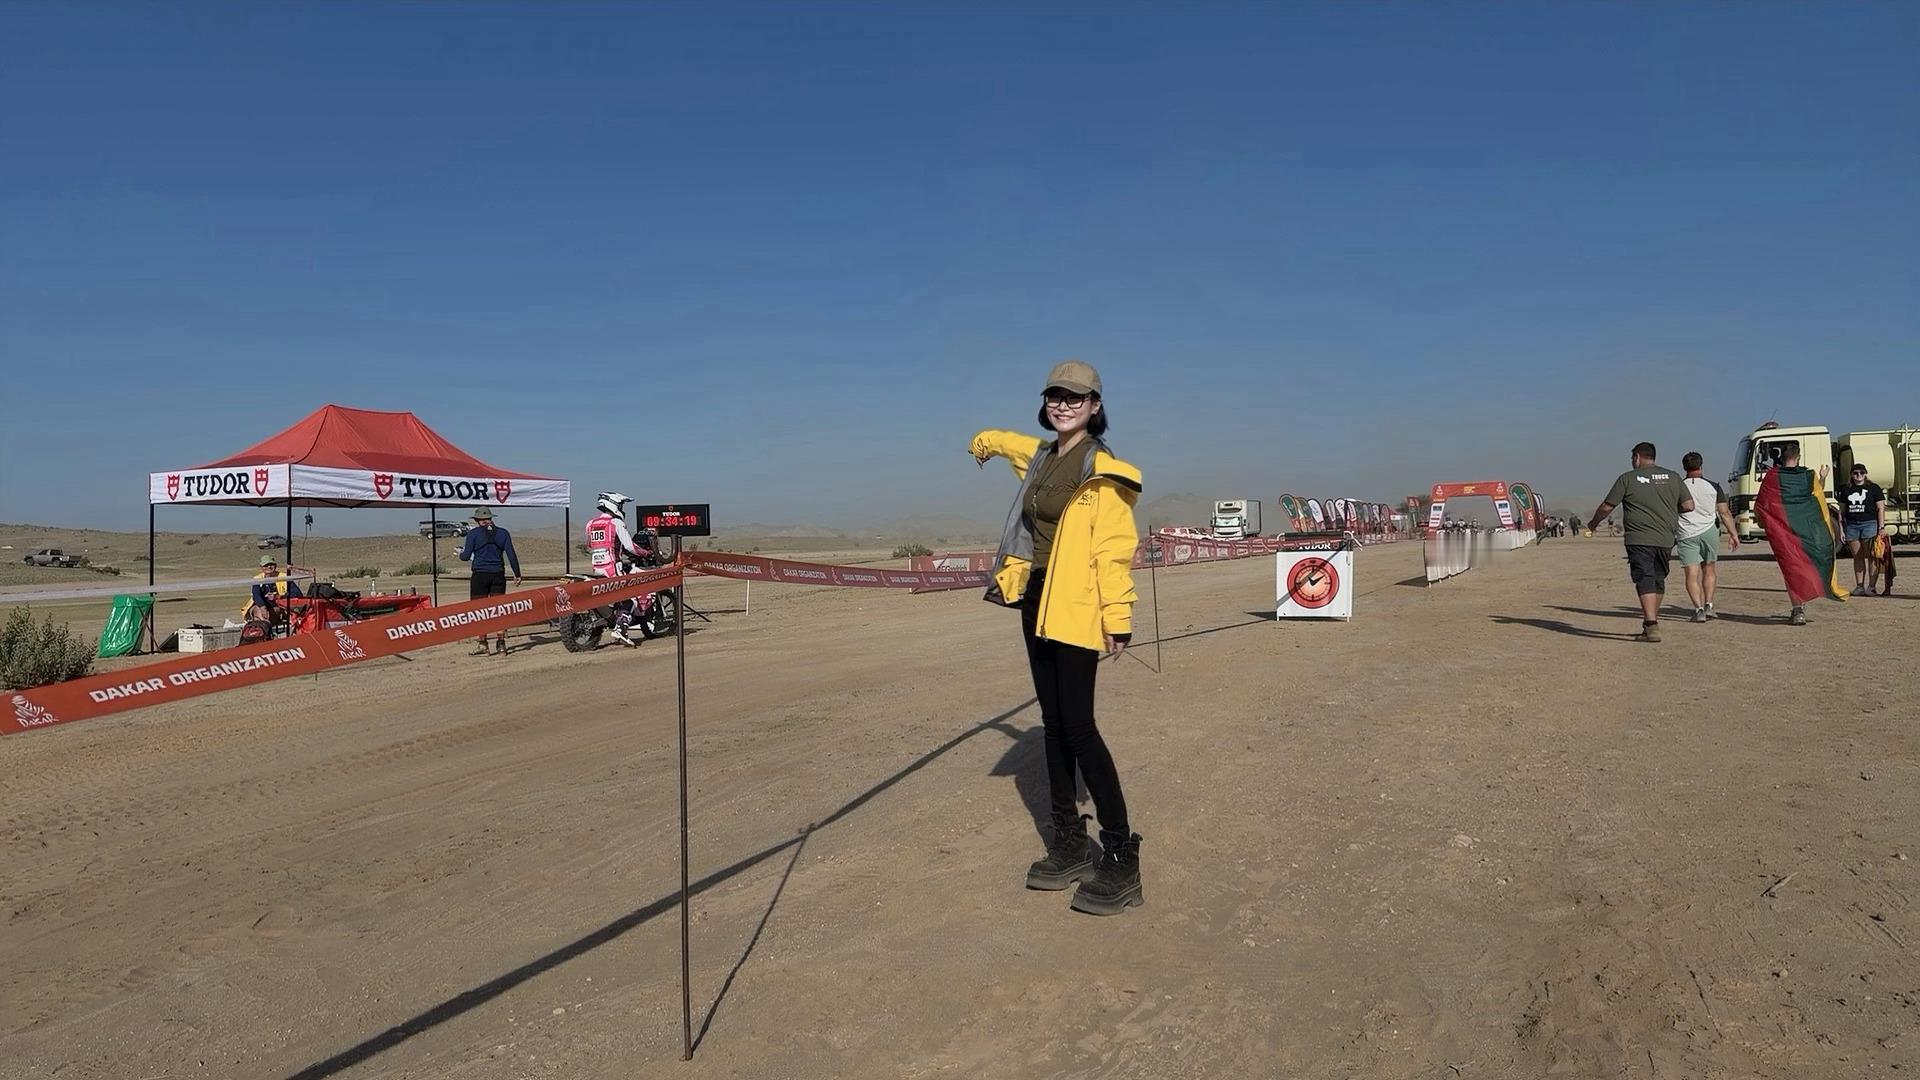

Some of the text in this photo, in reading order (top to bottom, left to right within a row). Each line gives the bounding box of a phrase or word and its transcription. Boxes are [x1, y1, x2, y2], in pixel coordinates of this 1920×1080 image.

[183, 472, 250, 496] TUDOR
[399, 477, 490, 501] TUDOR
[591, 580, 627, 595] DAKAR
[386, 598, 534, 641] DAKAR ORGANIZATION
[89, 647, 306, 704] DAKAR ORGANIZATION
[17, 712, 59, 728] DAKAR
